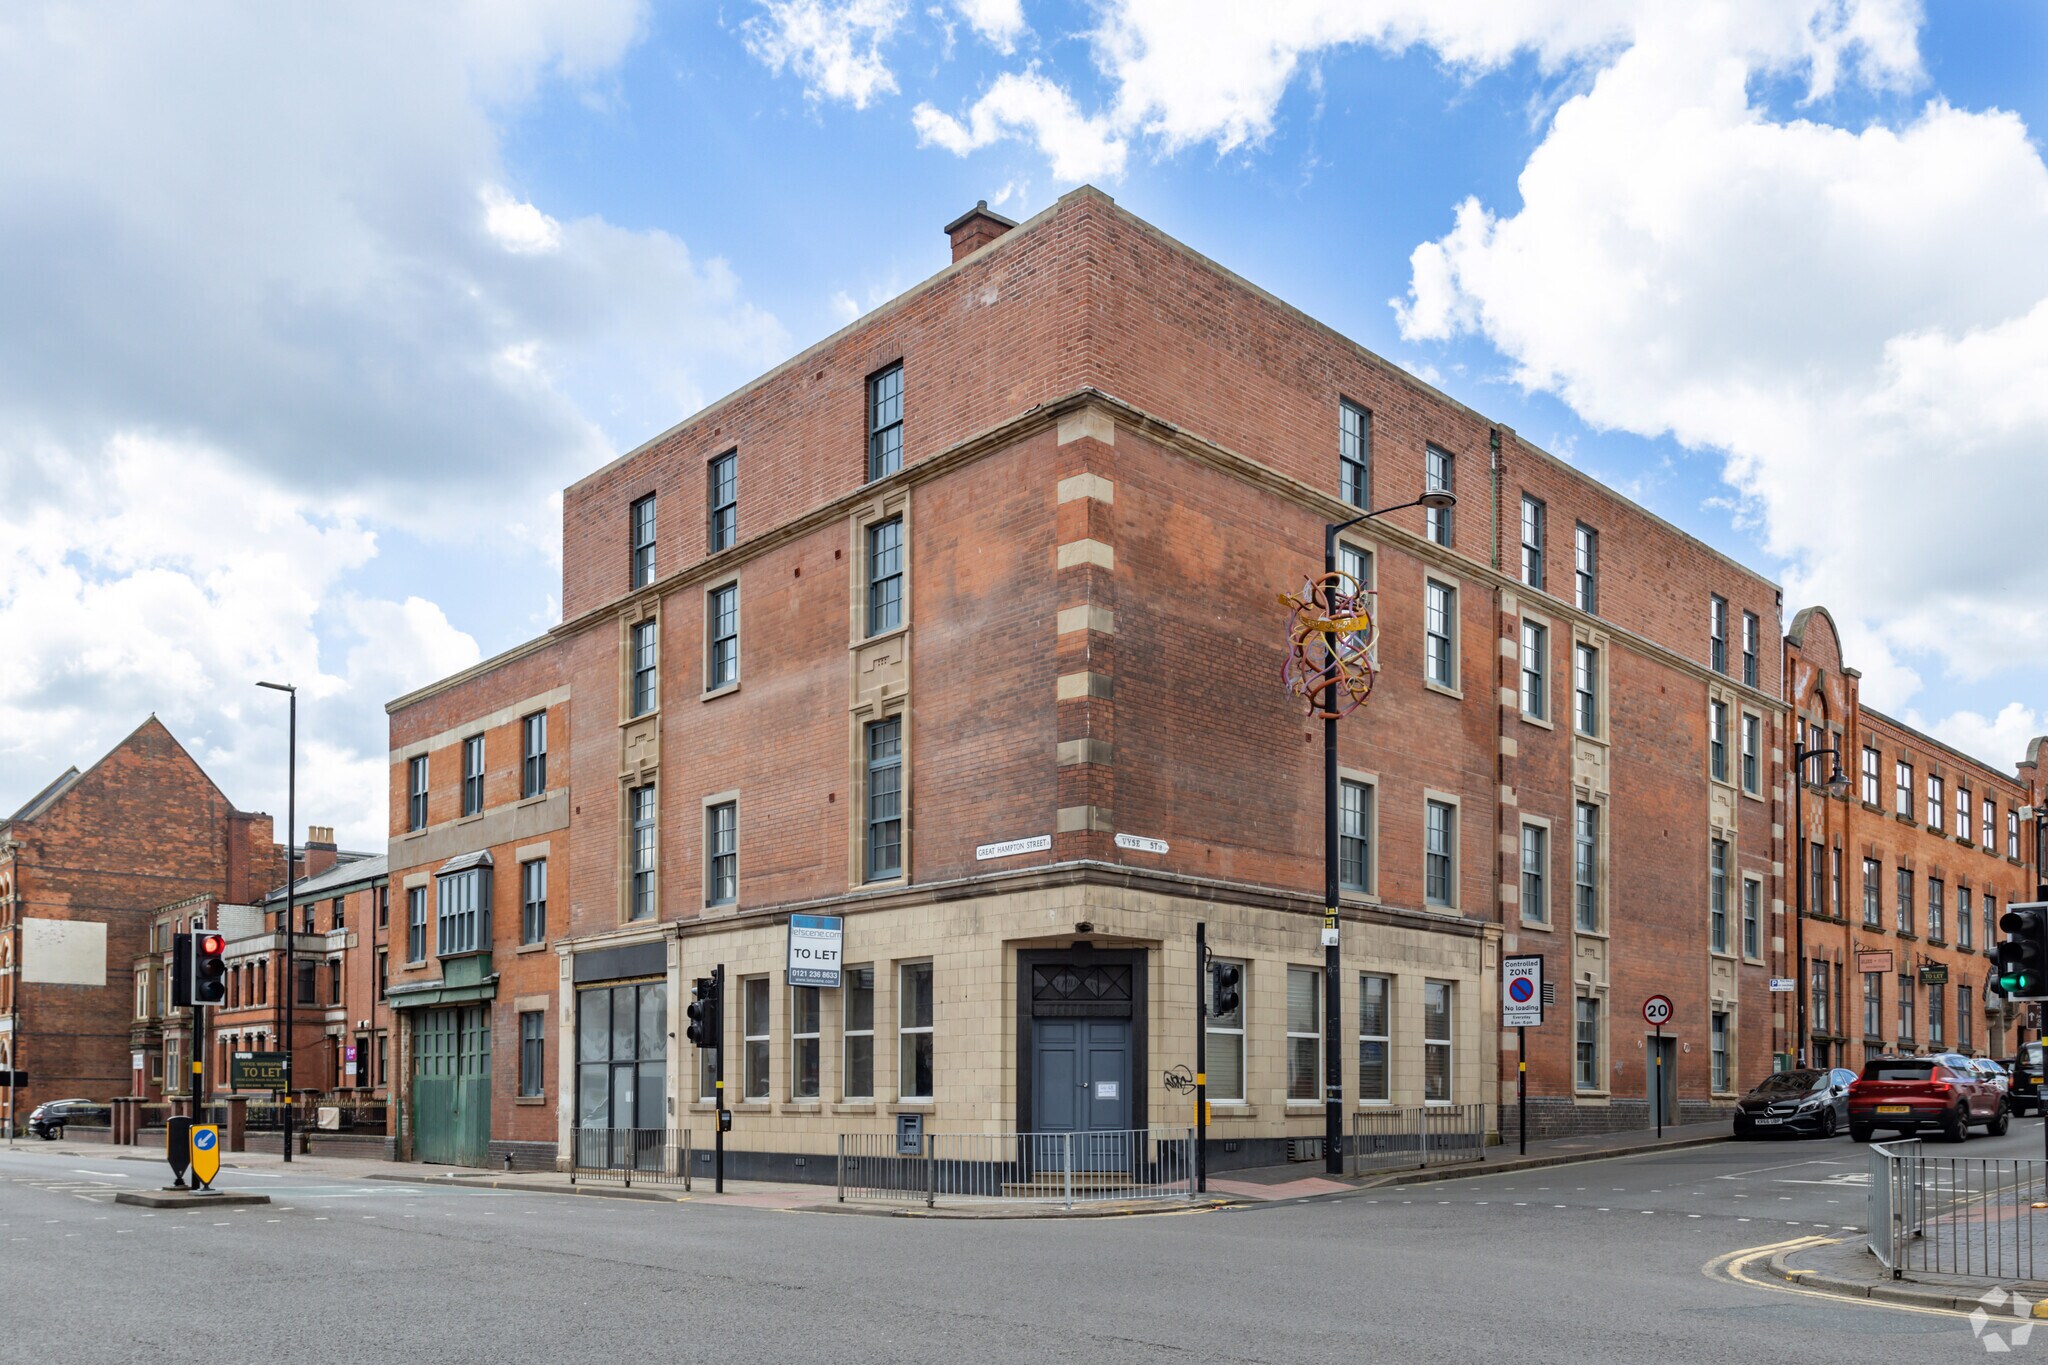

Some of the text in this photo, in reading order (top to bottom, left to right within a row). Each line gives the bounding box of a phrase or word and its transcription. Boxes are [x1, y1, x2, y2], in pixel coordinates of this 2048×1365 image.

[977, 847, 995, 856] GREAT
[997, 842, 1025, 854] HAMPTON
[1026, 838, 1047, 849] STREET
[1121, 837, 1140, 847] VYSE
[1150, 841, 1159, 850] ST
[794, 948, 837, 960] TO LET
[792, 969, 808, 977] 0121
[822, 971, 838, 979] 8633
[1647, 1004, 1668, 1017] 20
[243, 1067, 281, 1077] TO LET
